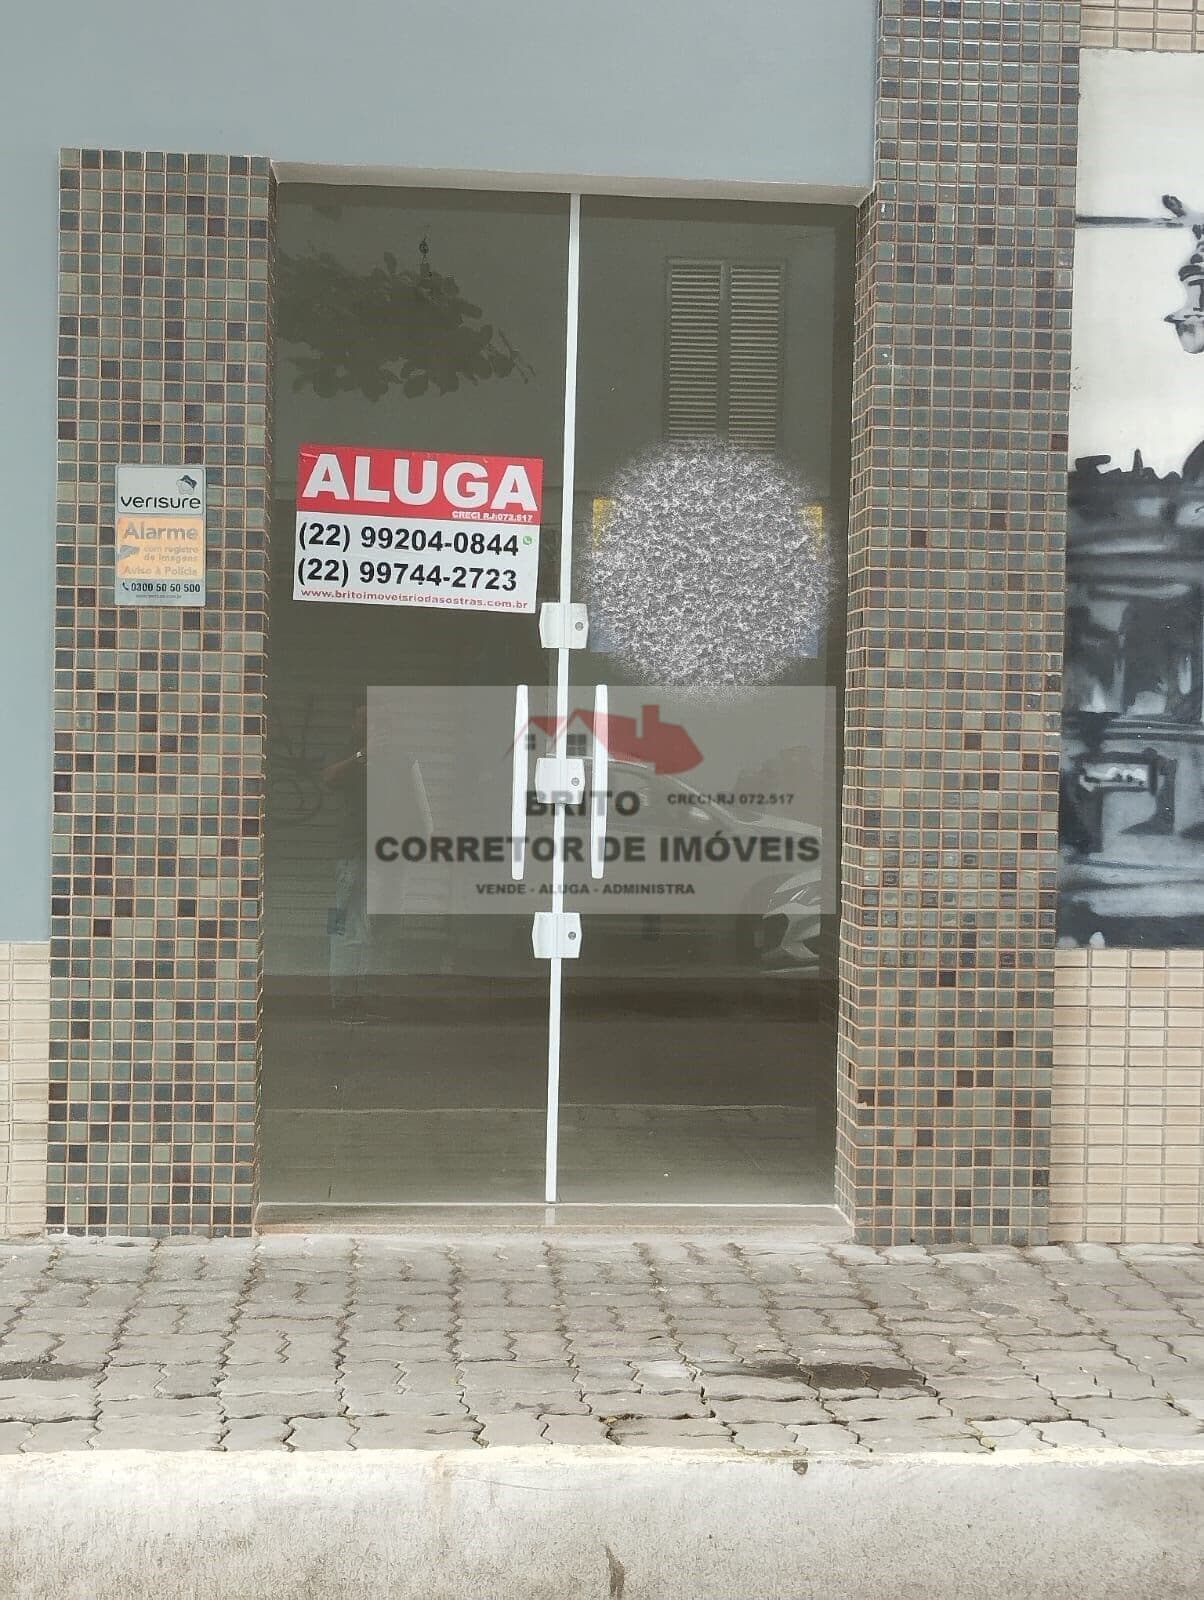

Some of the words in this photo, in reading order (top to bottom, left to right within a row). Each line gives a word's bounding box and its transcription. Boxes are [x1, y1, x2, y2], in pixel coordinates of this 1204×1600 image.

[302, 453, 538, 512] ALUGA
[120, 496, 201, 509] verisure
[452, 511, 481, 520] CRECI
[123, 522, 198, 540] Alarme
[299, 522, 350, 552] (22)
[361, 526, 519, 556] 99204-0844
[144, 553, 155, 561] de
[298, 557, 349, 587] (22)
[359, 561, 517, 592] 99744-2723
[131, 582, 153, 592] 0300
[156, 583, 167, 592] 50
[170, 583, 181, 592] 50
[183, 583, 201, 593] 500
[301, 588, 528, 609] www.britoimoveisriodasostras.com.br
